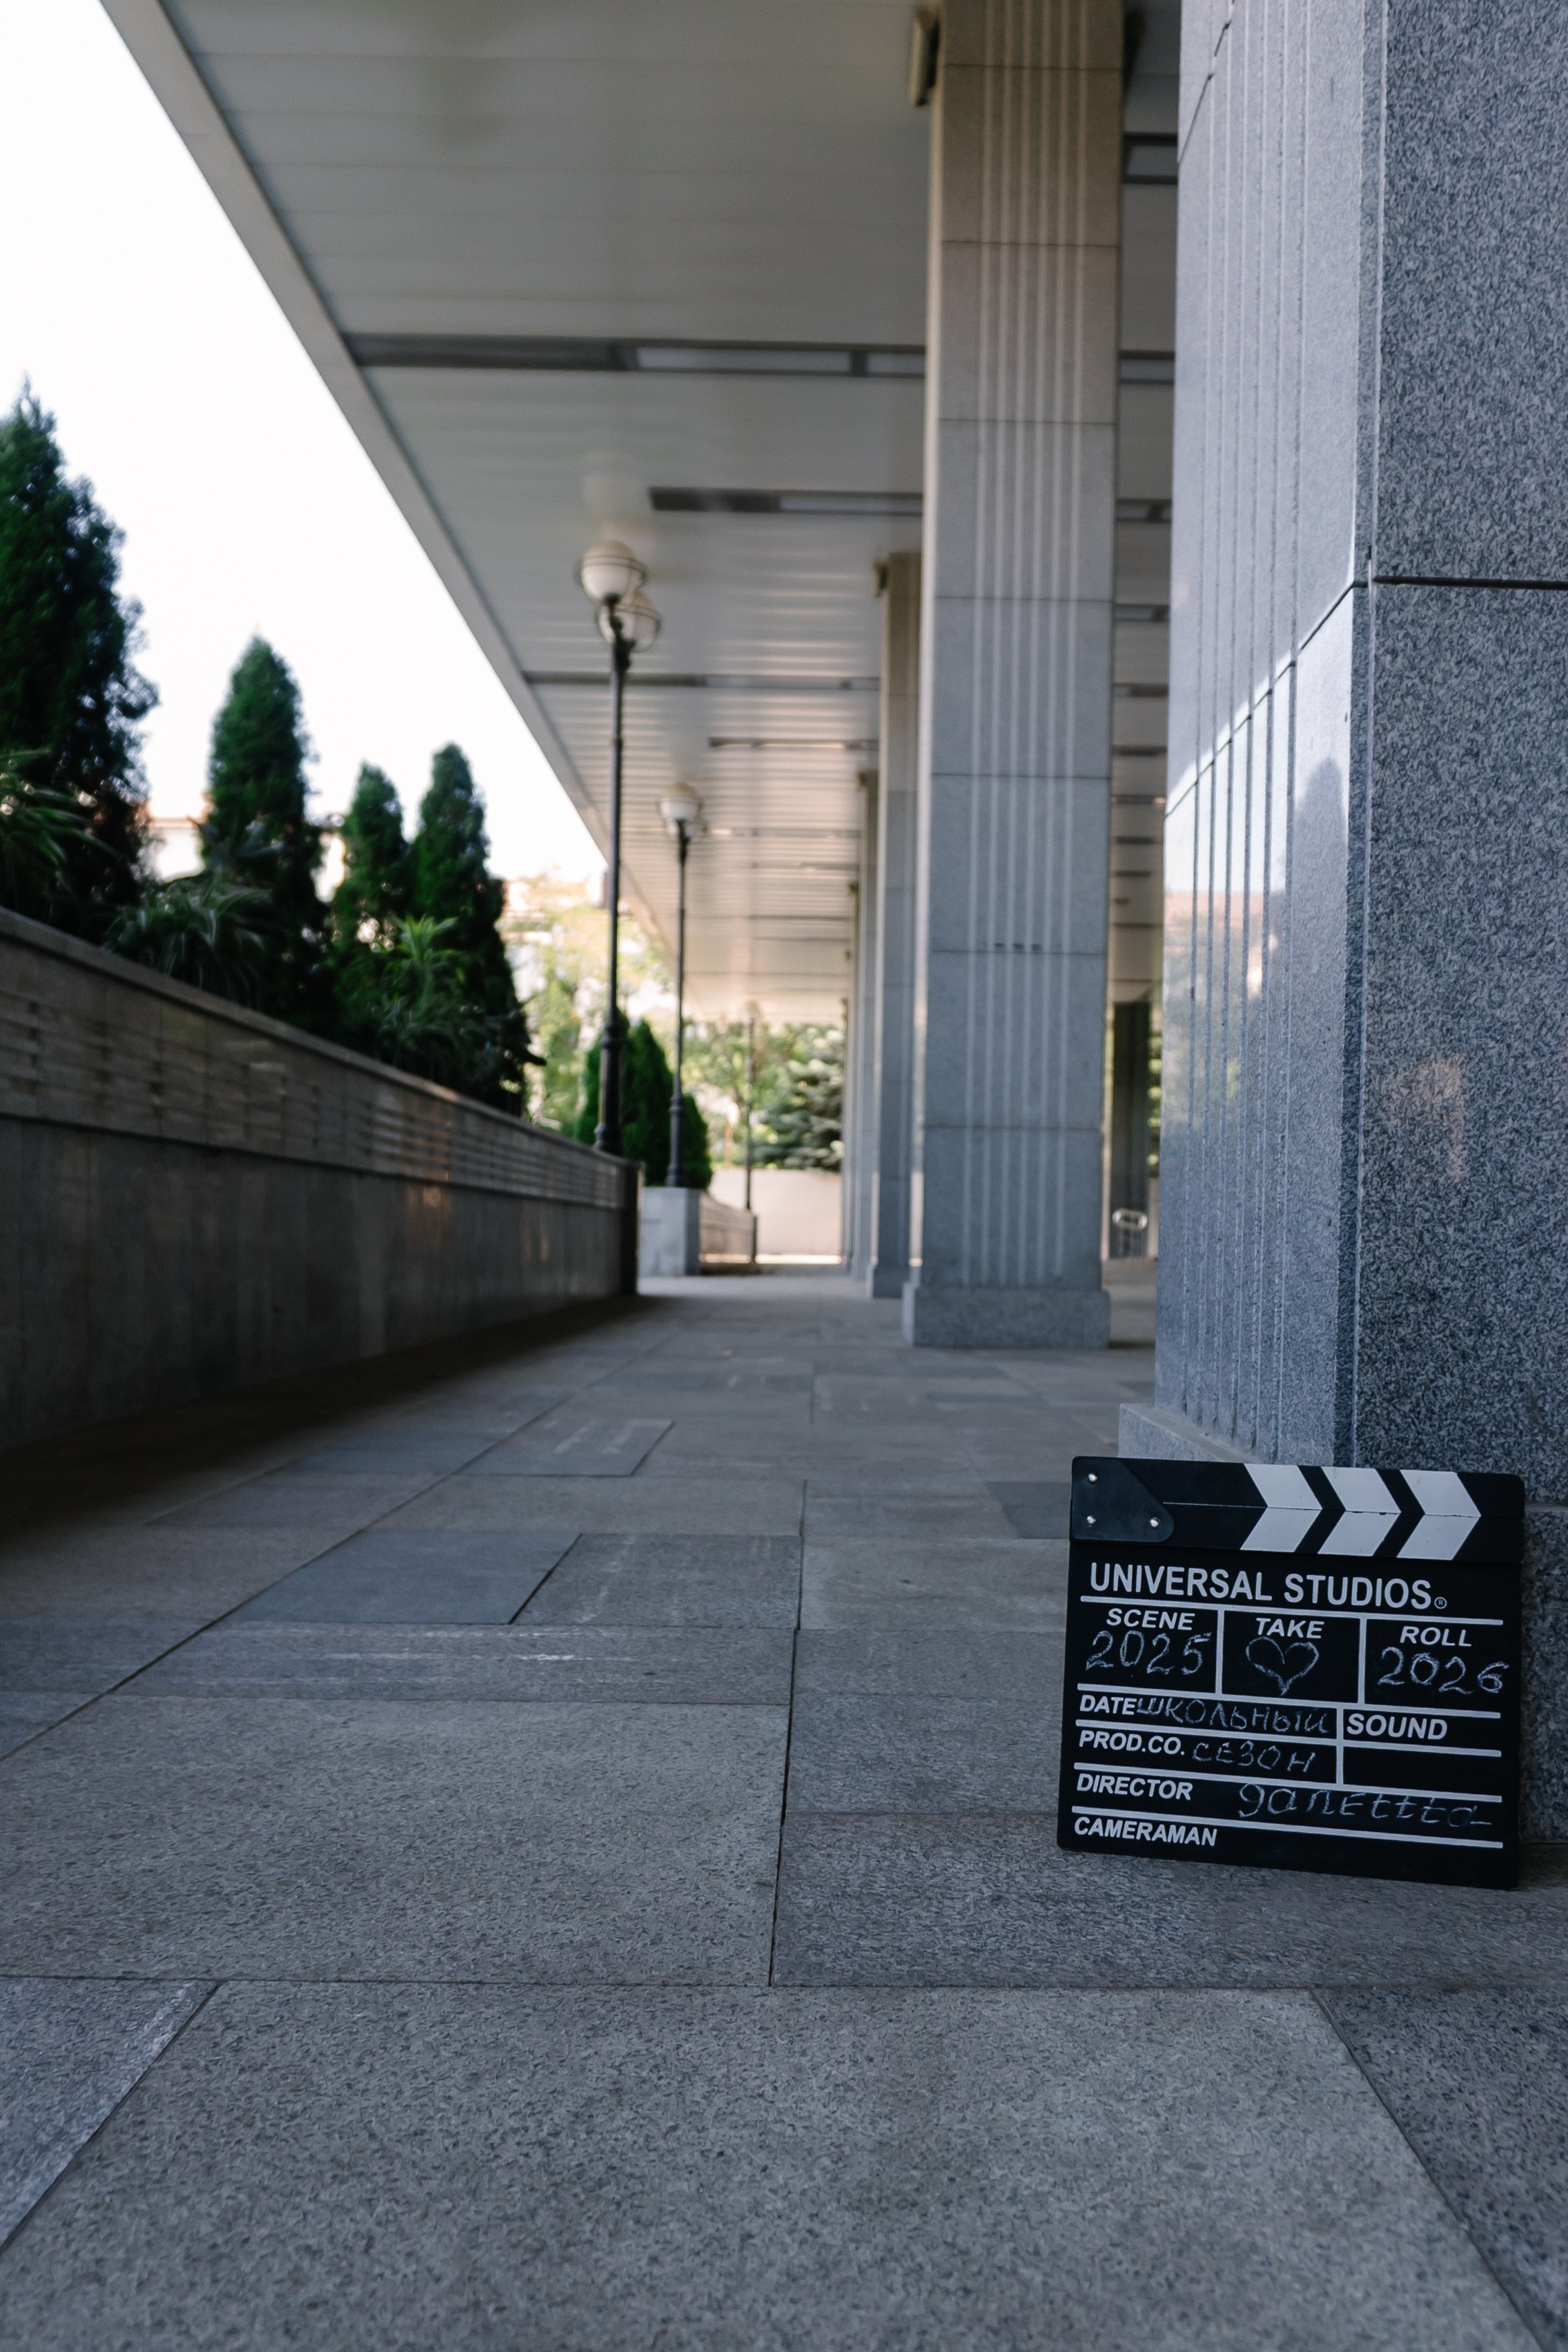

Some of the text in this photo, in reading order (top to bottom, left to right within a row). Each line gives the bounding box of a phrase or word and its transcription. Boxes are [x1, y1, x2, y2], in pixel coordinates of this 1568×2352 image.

[1090, 1562, 1272, 1601] UNIVERSAL
[1106, 1608, 1195, 1631] SCENE
[1255, 1617, 1324, 1639] TAKE
[1400, 1625, 1472, 1647] ROLL
[1085, 1629, 1213, 1675] 2025
[1377, 1646, 1509, 1695] 2026
[1079, 1694, 1137, 1715] DATE
[1346, 1713, 1448, 1741] SOUND
[1079, 1729, 1186, 1756] PROD.CO.
[1077, 1773, 1193, 1801] DIRECTOR
[1074, 1816, 1217, 1847] CAMERAMAN
